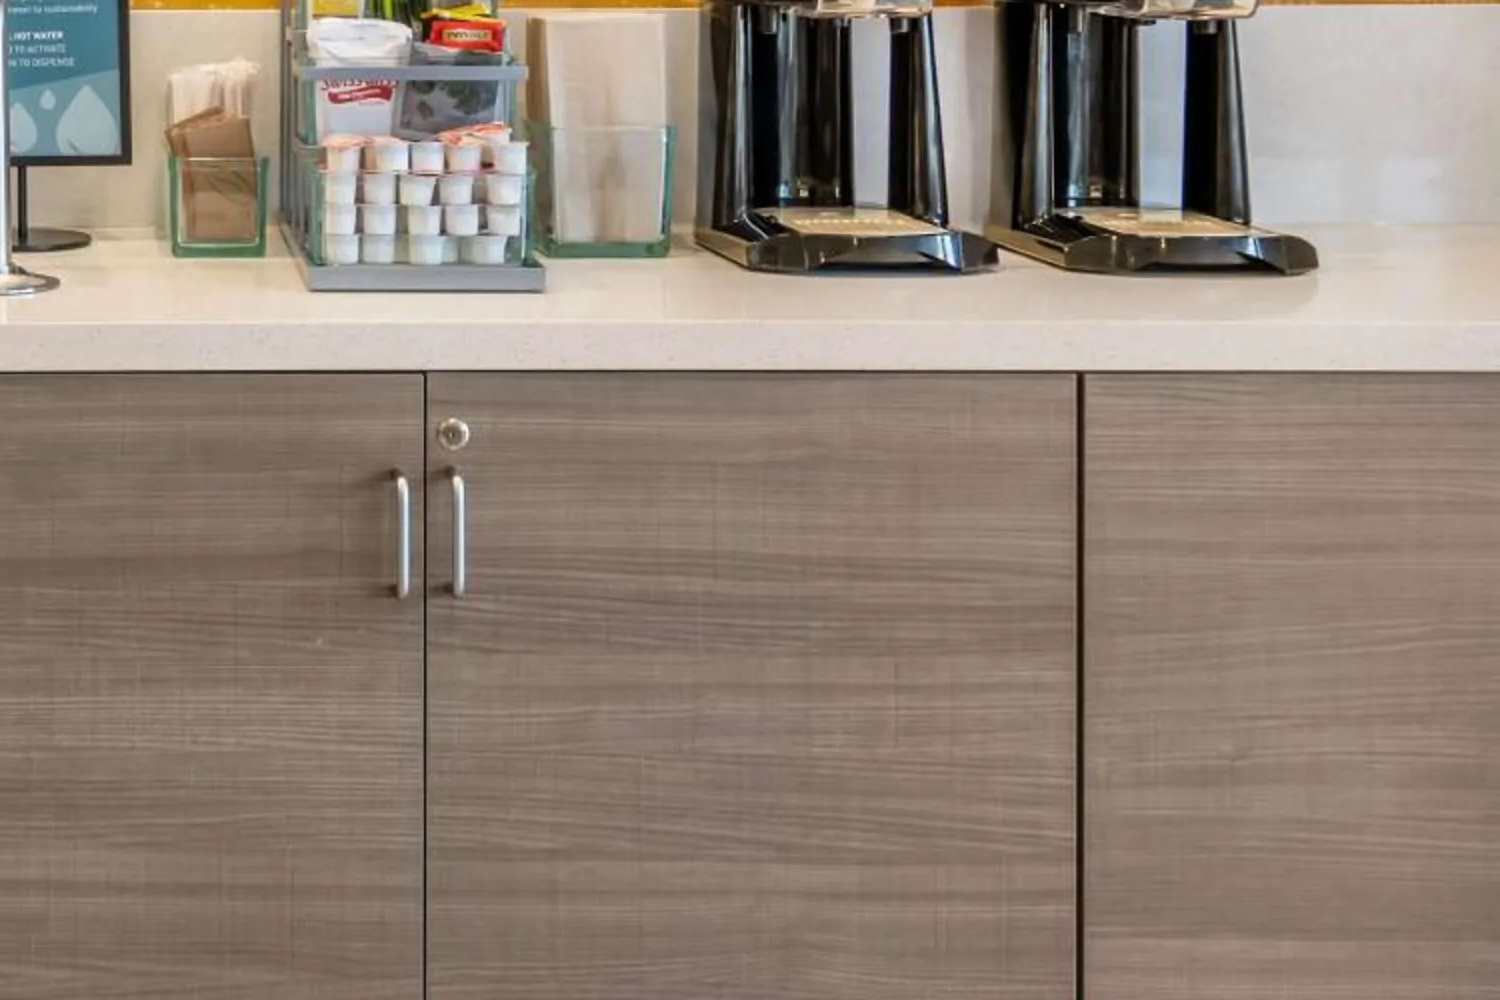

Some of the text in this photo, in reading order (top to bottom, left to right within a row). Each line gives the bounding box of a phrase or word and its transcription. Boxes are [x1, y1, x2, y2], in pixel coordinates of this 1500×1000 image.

[13, 30, 64, 41] HOT WATER
[19, 57, 31, 67] TO
